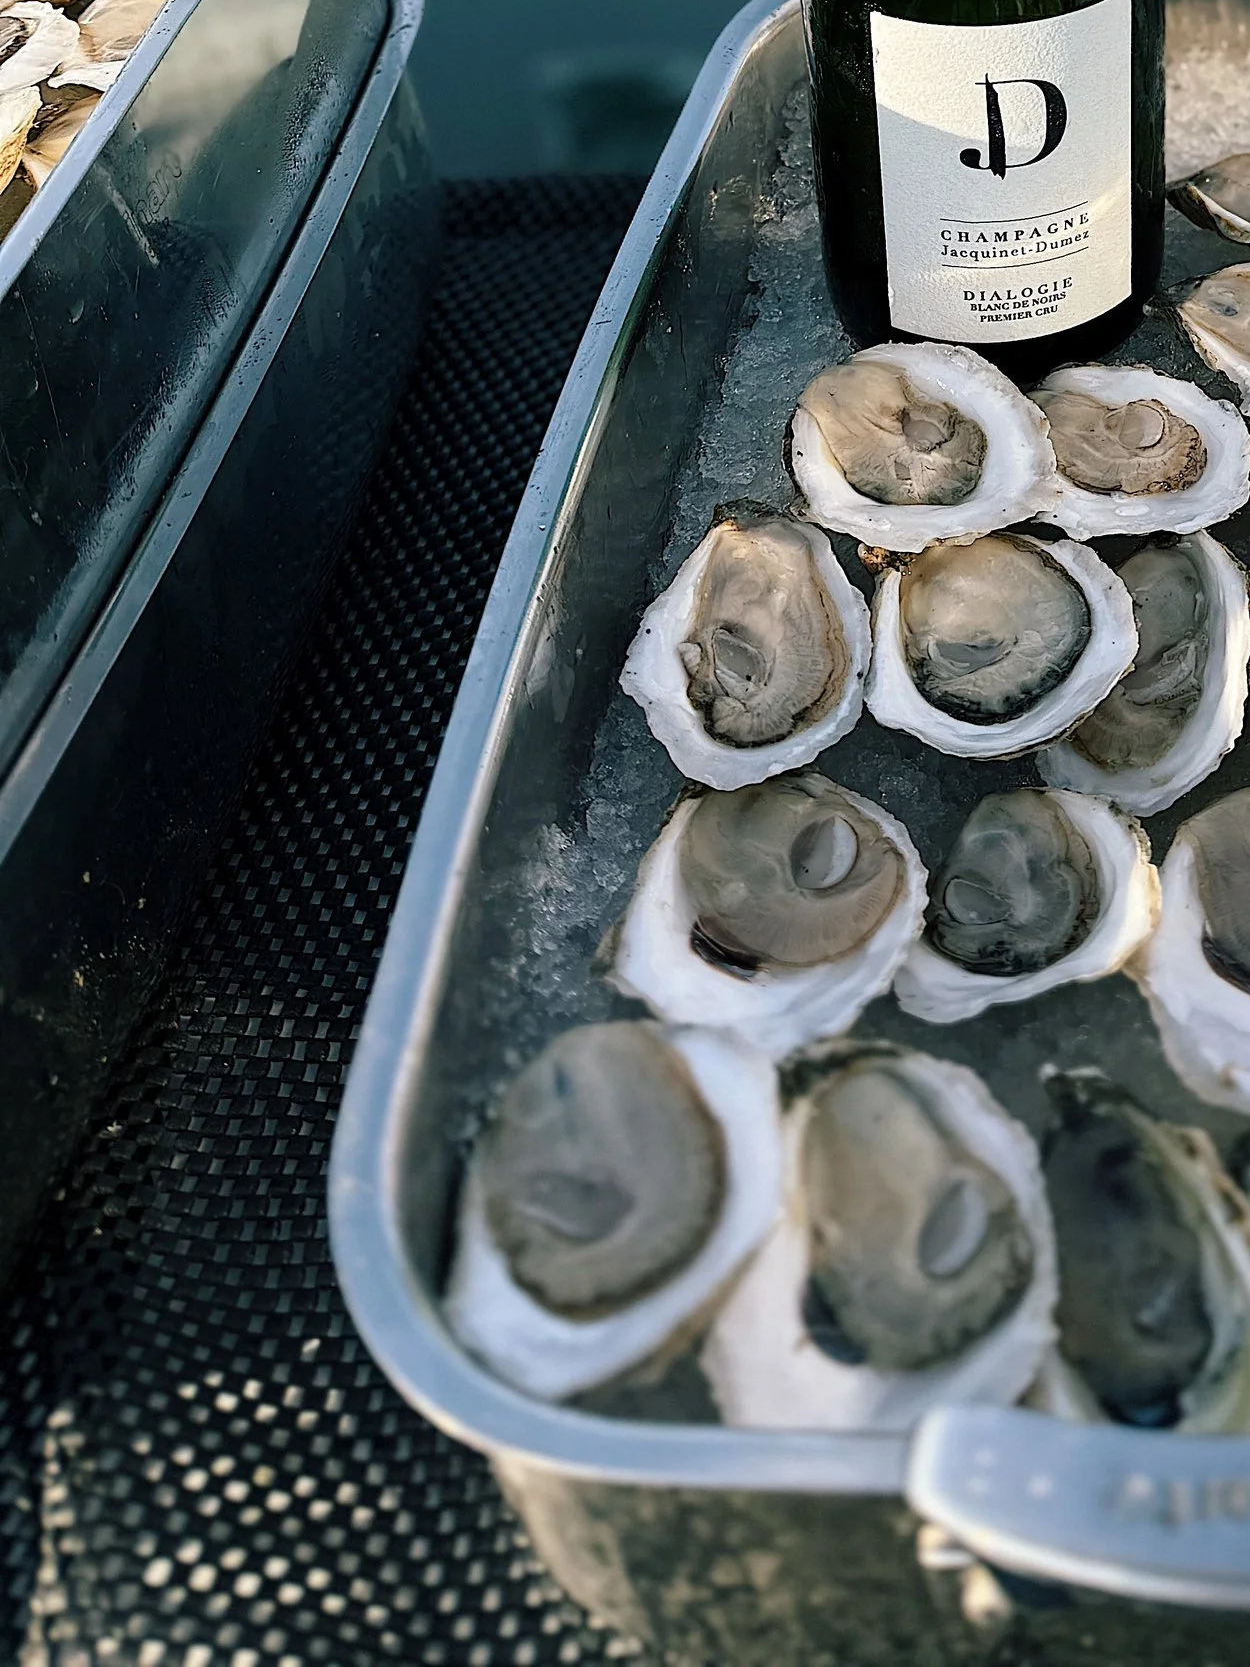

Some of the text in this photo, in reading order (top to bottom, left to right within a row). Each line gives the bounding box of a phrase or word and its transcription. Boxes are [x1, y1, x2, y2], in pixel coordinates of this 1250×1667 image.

[940, 212, 1090, 243] CHAMPAGNE
[940, 230, 1090, 262] Jacquinet-Dumez
[963, 277, 1073, 302] DIALOGIE
[970, 291, 1066, 312] BLANC DE NOIRS
[979, 305, 1059, 323] PREMIER CRU
